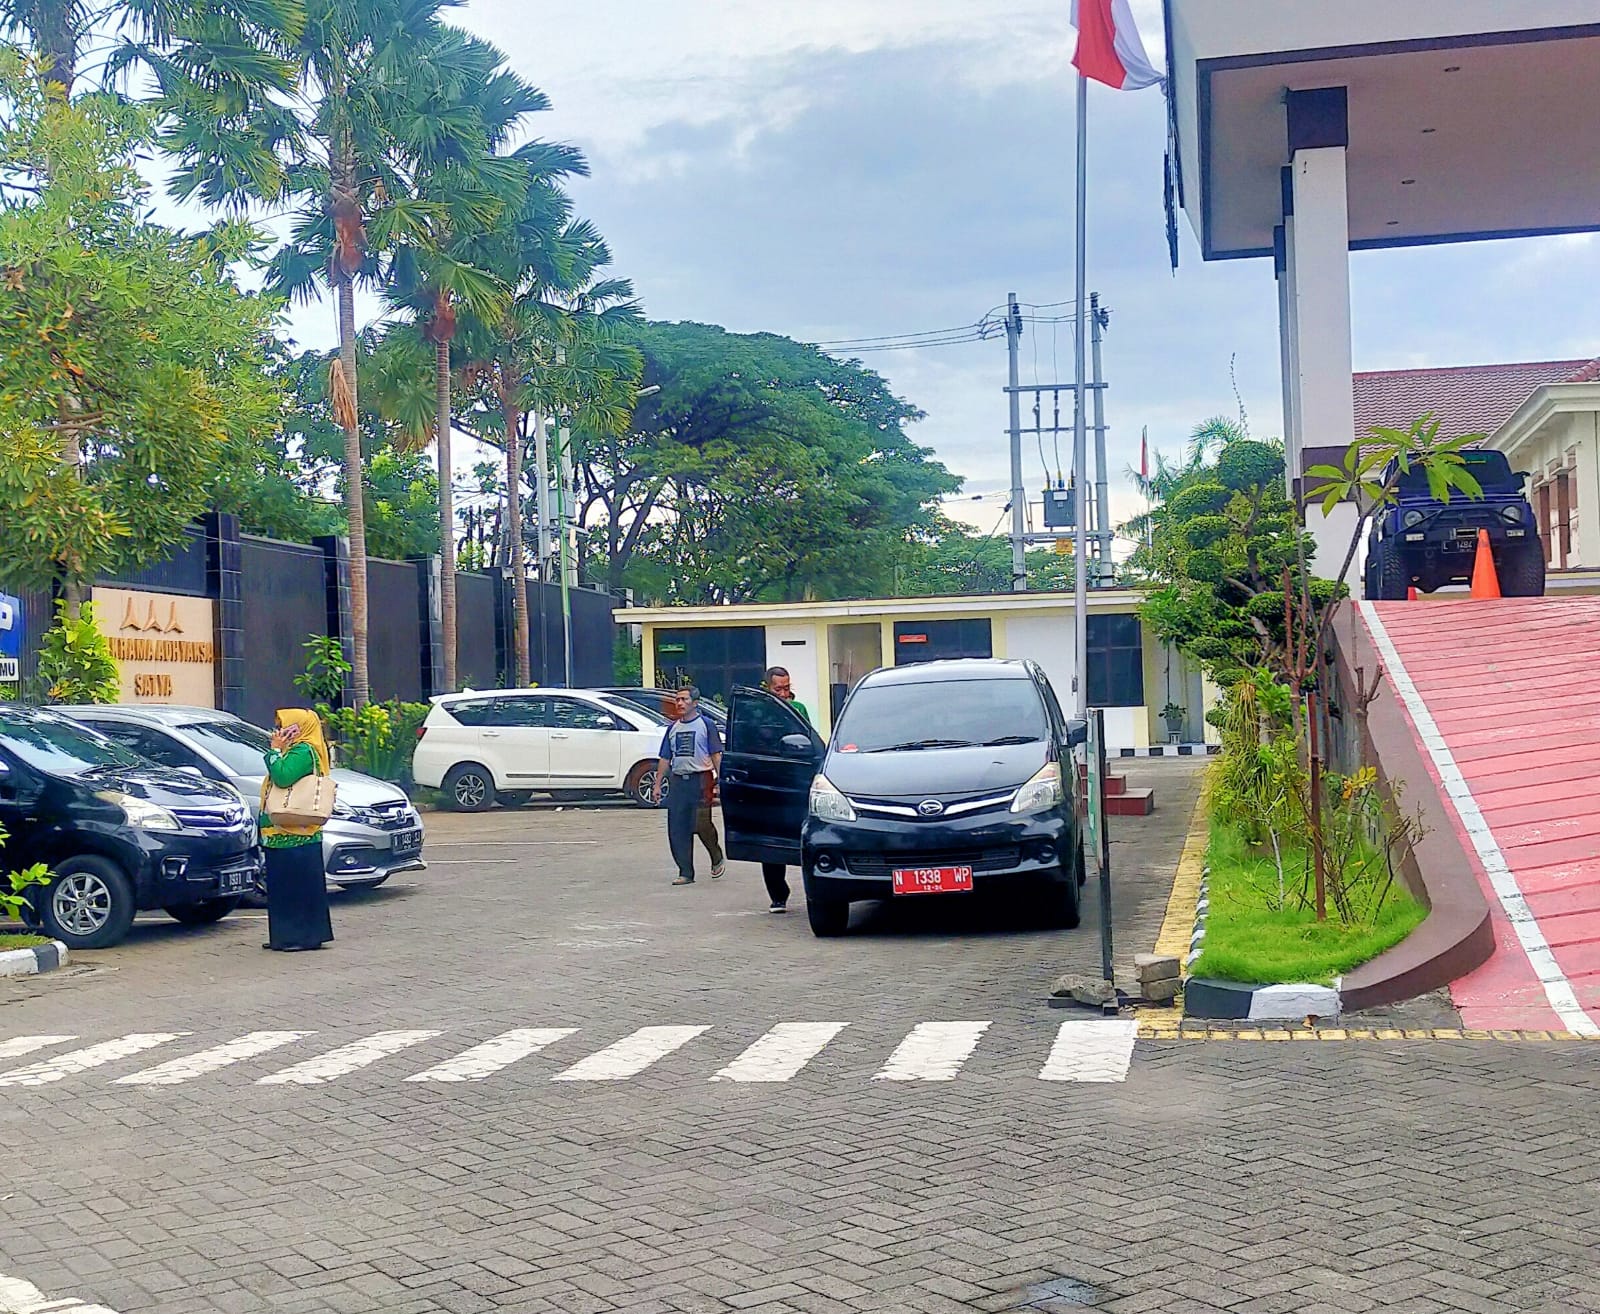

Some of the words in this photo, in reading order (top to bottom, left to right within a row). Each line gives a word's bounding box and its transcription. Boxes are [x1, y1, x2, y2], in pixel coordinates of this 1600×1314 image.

[895, 871, 904, 886] N
[914, 869, 942, 885] 1338
[954, 867, 970, 883] WP
